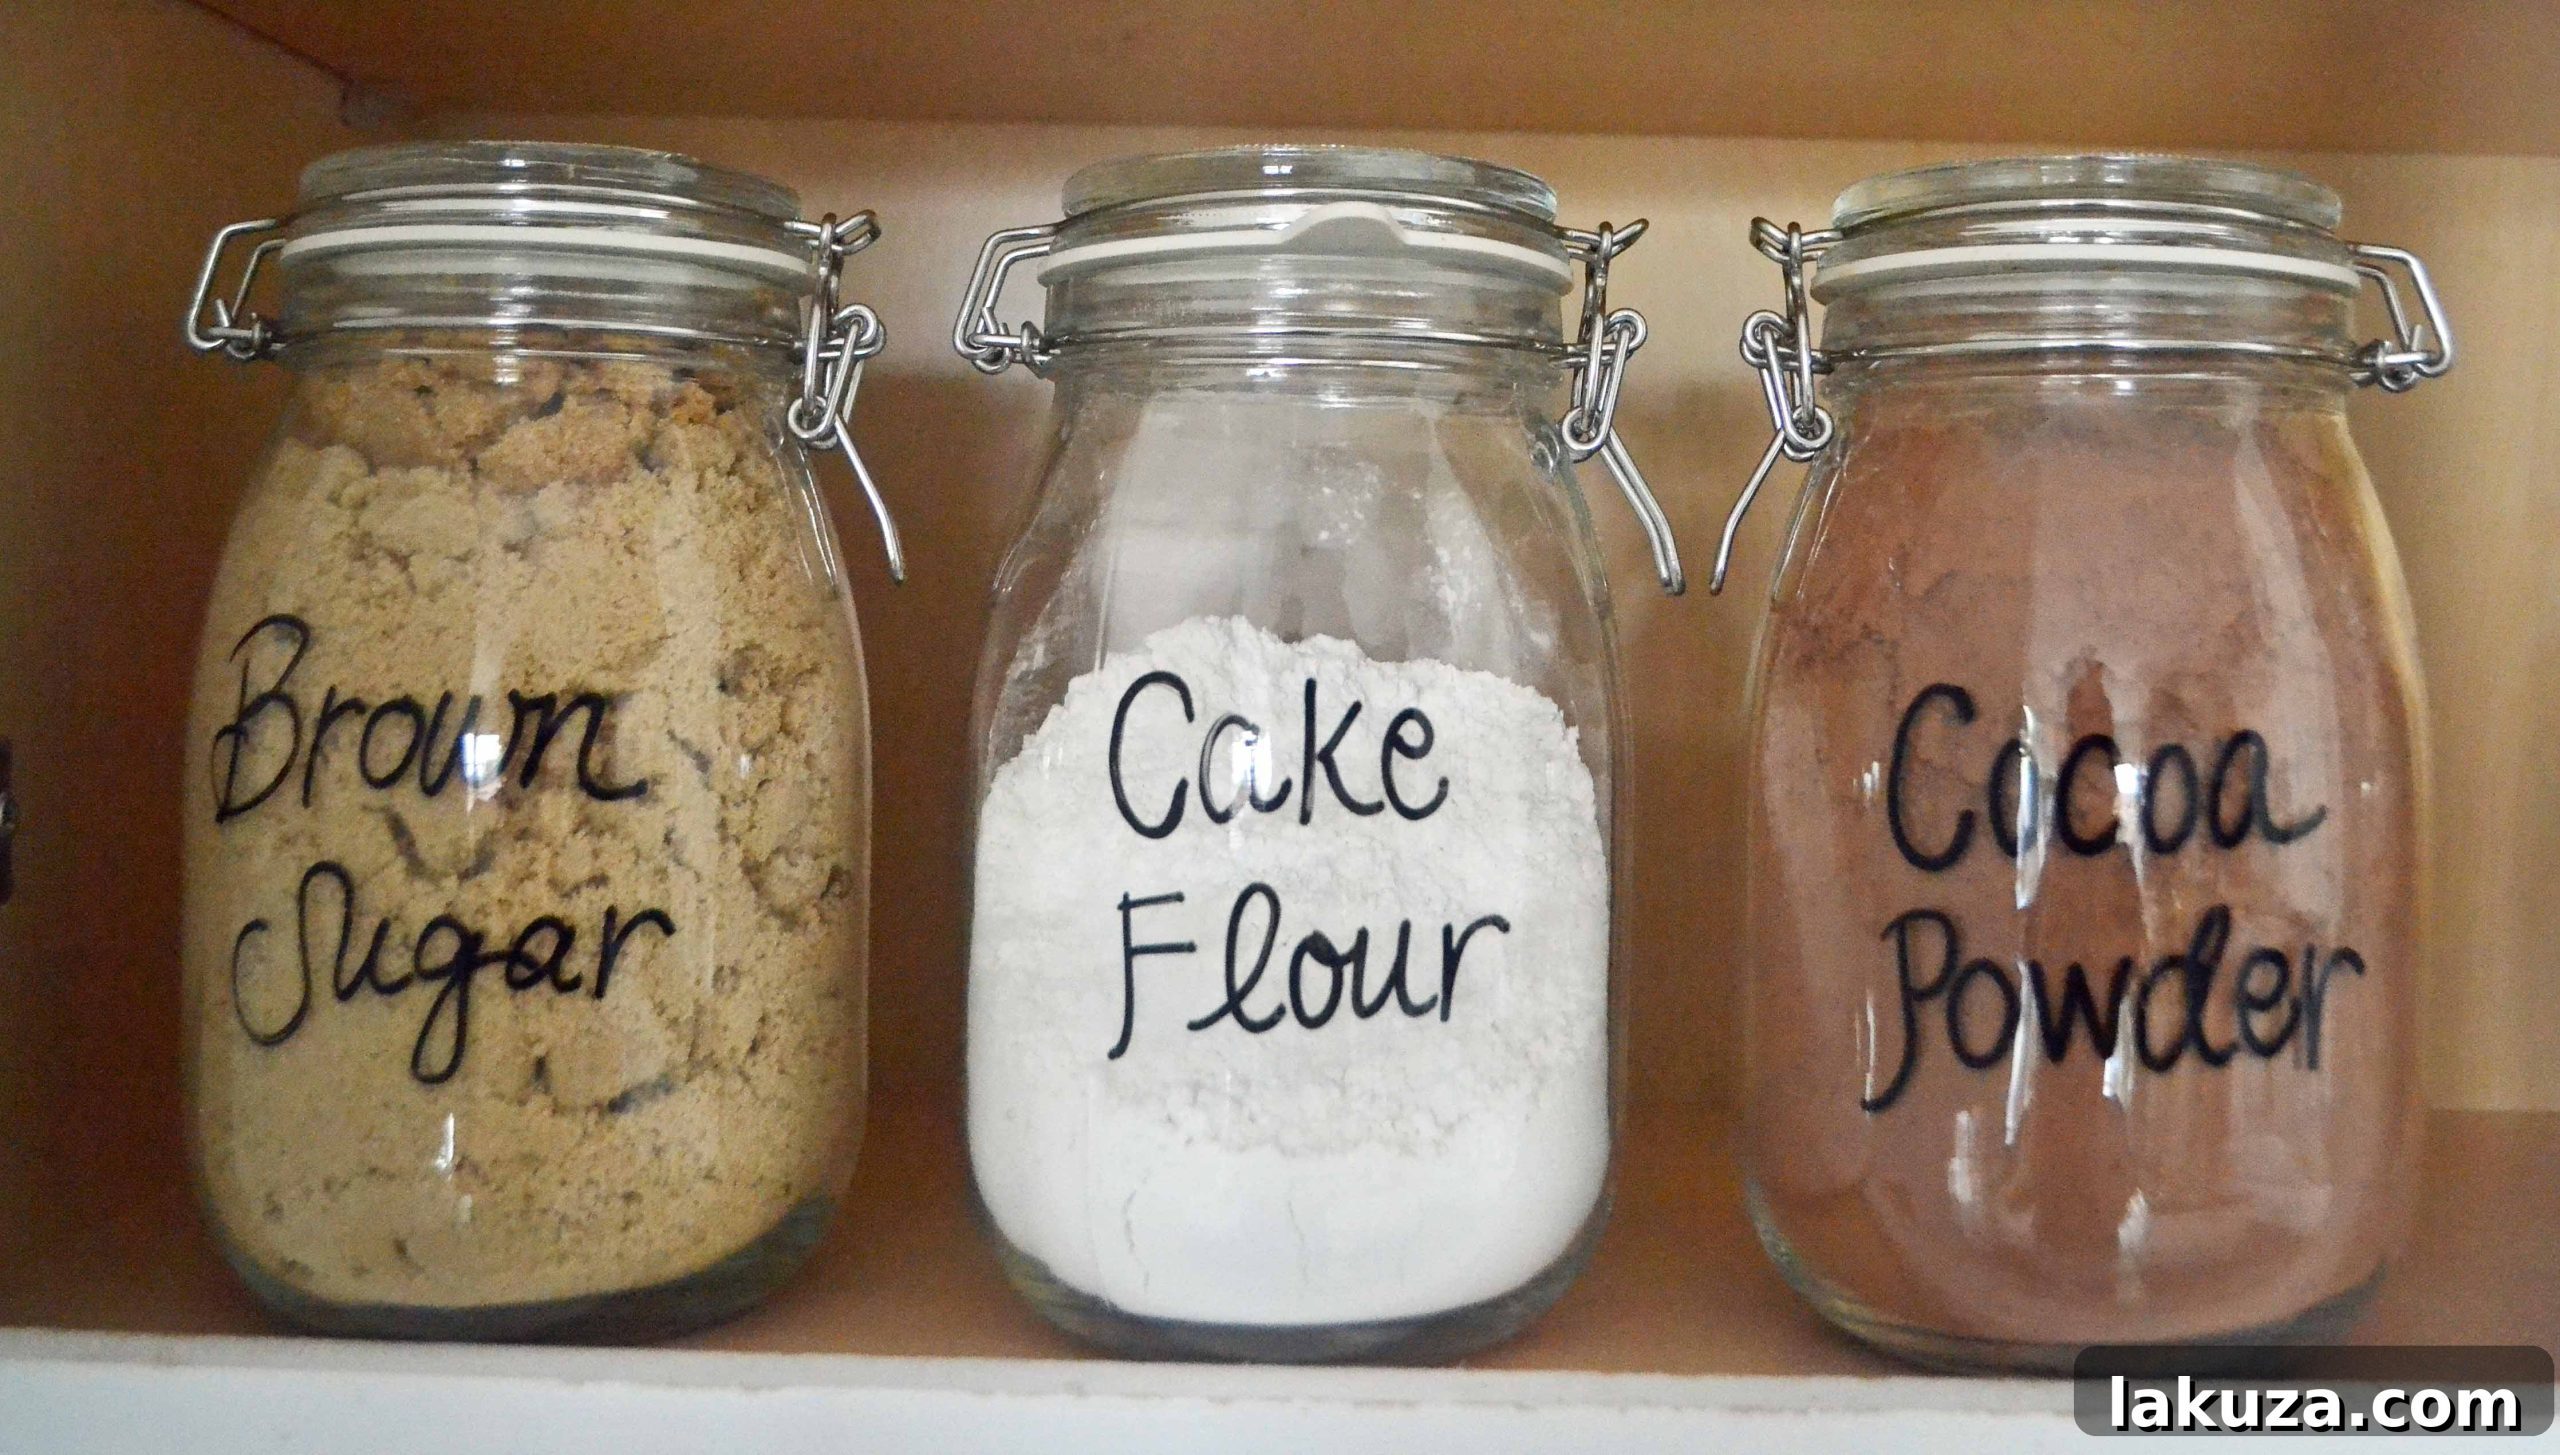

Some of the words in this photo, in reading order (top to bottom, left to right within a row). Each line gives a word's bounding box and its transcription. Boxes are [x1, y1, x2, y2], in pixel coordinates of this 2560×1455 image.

[212, 613, 648, 824] Brown
[1108, 671, 1449, 839] Cake
[1887, 683, 2328, 872] Cocoa
[232, 860, 676, 1085] Sugar
[1107, 882, 1511, 1060] Flour
[1860, 904, 2365, 1115] Powder
